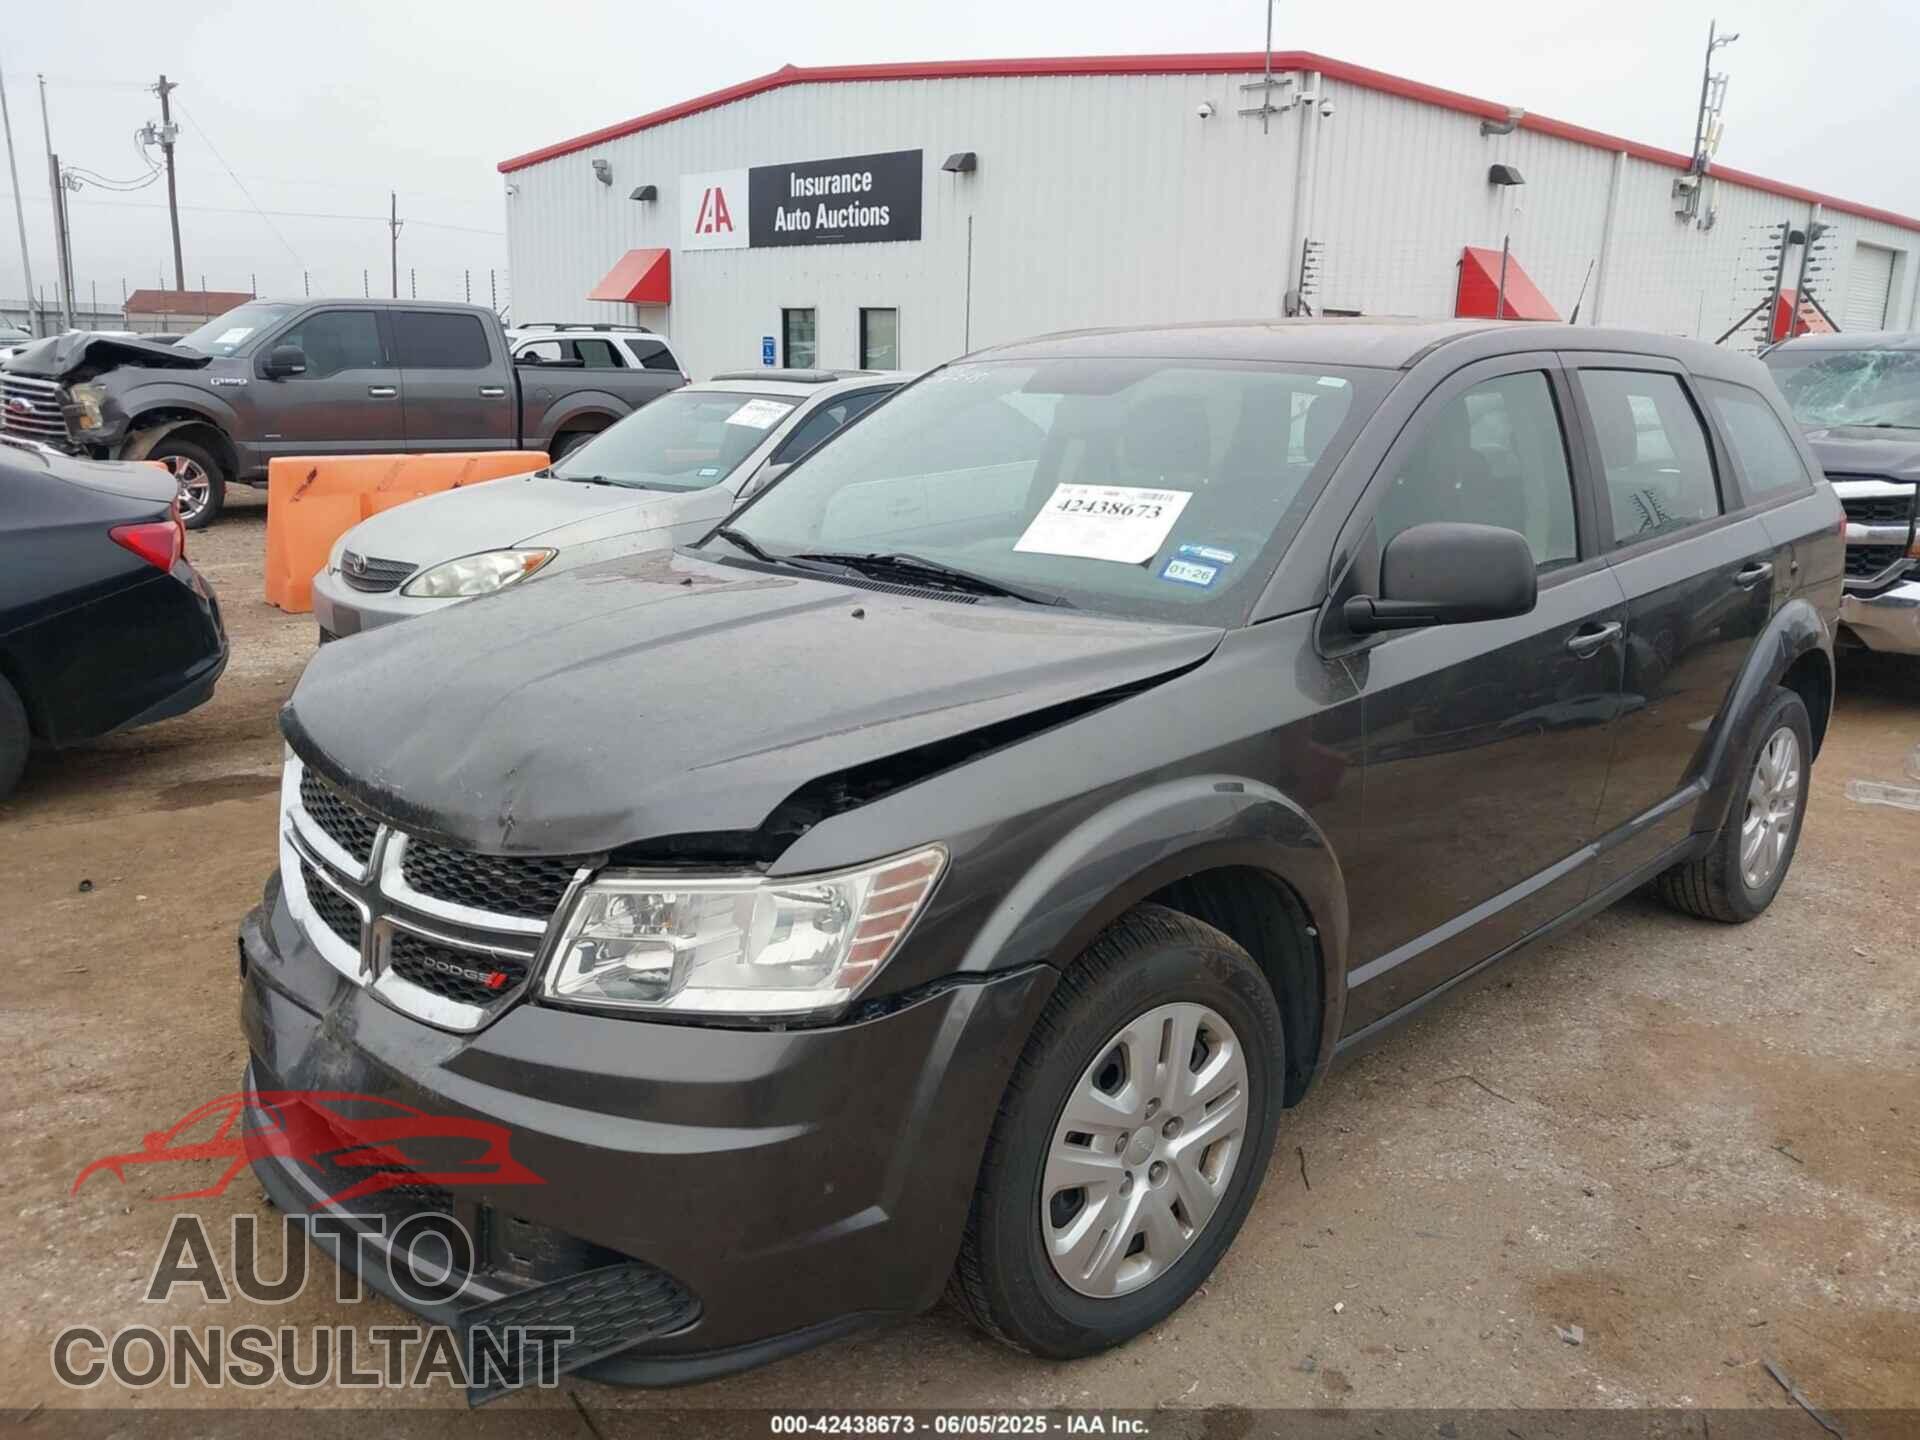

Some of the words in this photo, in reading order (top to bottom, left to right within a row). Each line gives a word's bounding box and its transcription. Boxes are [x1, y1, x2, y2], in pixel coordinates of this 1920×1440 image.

[790, 171, 872, 197] Insurance
[774, 206, 811, 232] Auto
[815, 201, 890, 230] Auctions
[1056, 498, 1163, 519] 42438673
[424, 956, 489, 984] DODGE
